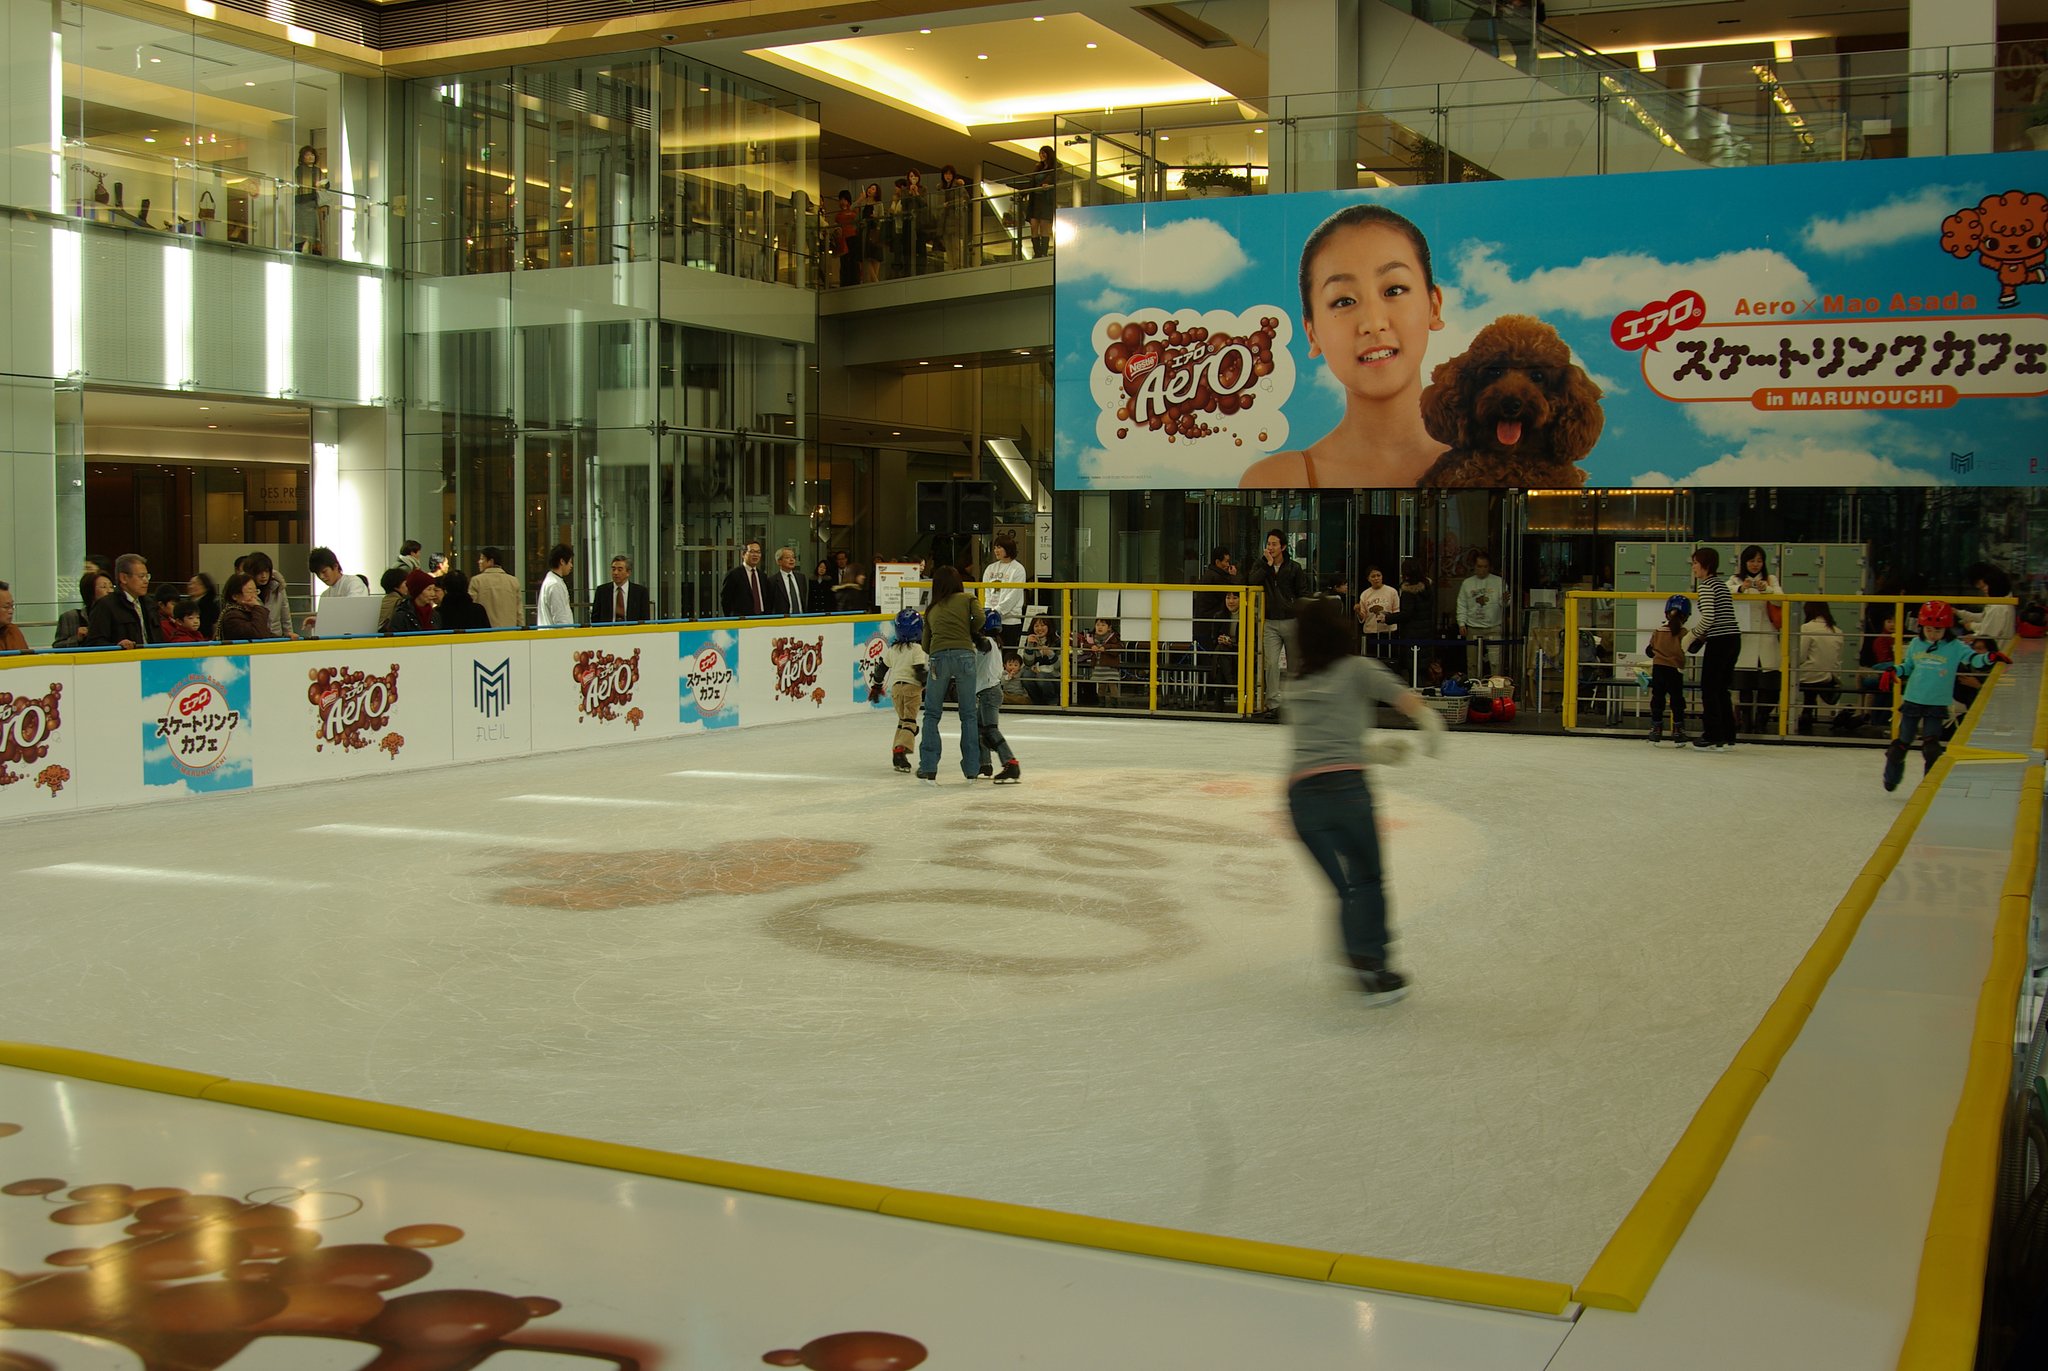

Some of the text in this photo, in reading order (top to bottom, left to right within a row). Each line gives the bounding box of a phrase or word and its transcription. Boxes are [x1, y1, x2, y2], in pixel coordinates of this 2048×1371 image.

[1735, 298, 1796, 316] Aero
[1823, 295, 1881, 313] Mao
[1889, 291, 1977, 311] Asada
[1620, 296, 1695, 342] エアロ
[1171, 345, 1206, 368] エアロ
[1673, 330, 2048, 381] スケートリンクカフェ
[1766, 388, 1944, 406] in MARUNOUCHI
[260, 487, 279, 499] DES
[686, 670, 732, 687] スケートリンク
[699, 687, 721, 701] カフェ
[157, 712, 239, 737] スケートリンク
[181, 735, 218, 755] カフェ
